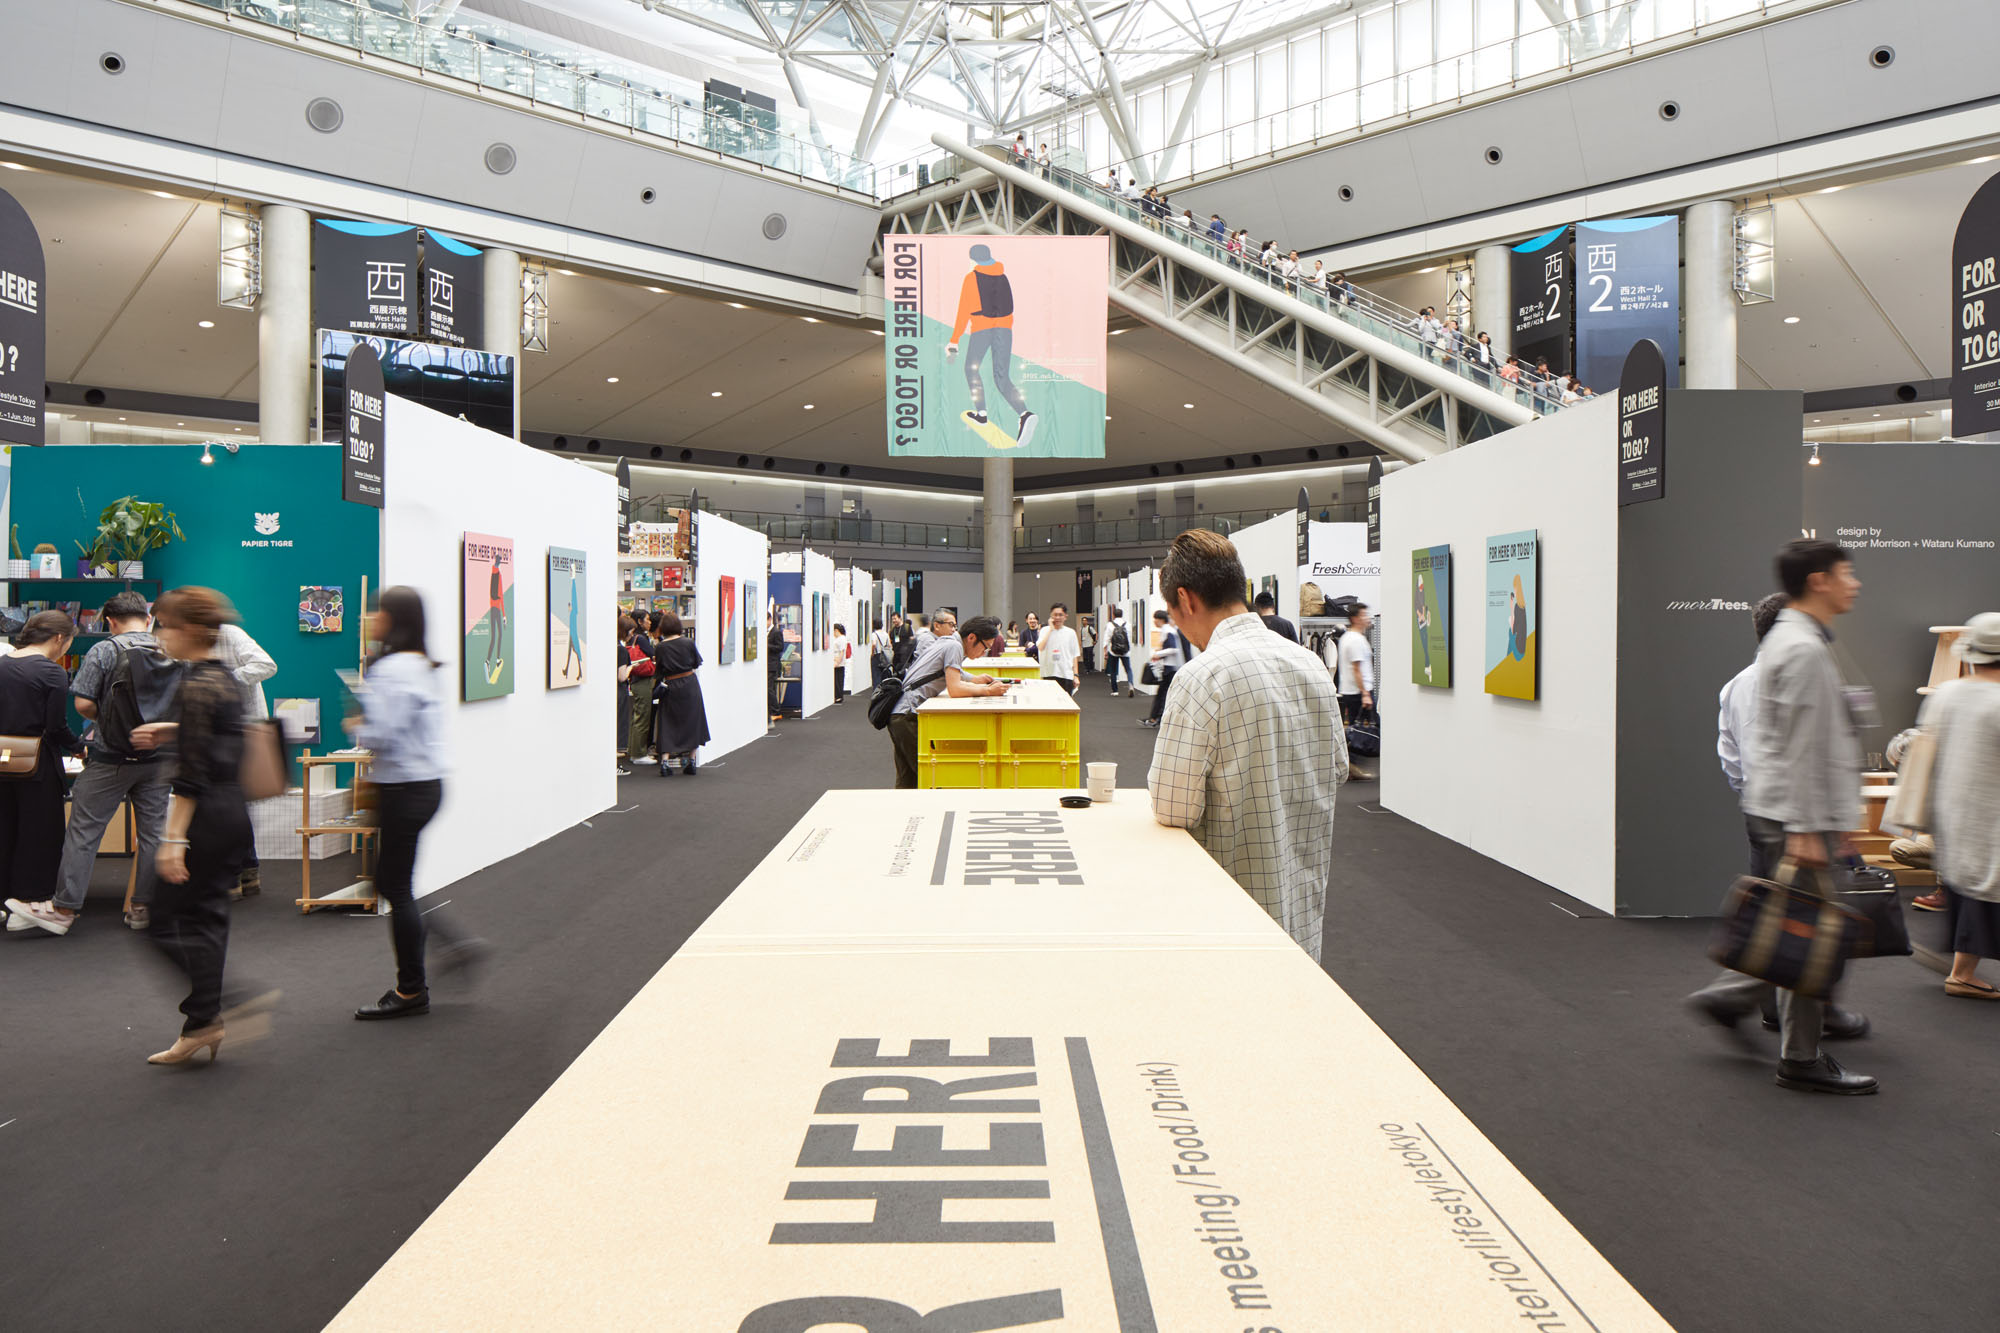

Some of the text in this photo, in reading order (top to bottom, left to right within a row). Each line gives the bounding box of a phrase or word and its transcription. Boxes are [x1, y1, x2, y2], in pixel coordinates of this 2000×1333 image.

[1545, 251, 1563, 284] 西
[1587, 243, 1617, 274] 西
[366, 261, 406, 302] 西
[1962, 256, 1996, 292] FOR
[429, 268, 454, 312] 西
[1546, 283, 1561, 322] 2
[1588, 274, 1614, 312] 2
[1620, 284, 1664, 296] 西2ホール
[1620, 295, 1636, 303] West
[1638, 294, 1651, 302] Hall
[374, 314, 390, 322] West
[1962, 299, 1985, 330] OR
[8, 344, 19, 372] ?
[1986, 330, 2000, 358] G
[18, 394, 36, 406] Tokyo
[1622, 386, 1658, 414] FOR HERE
[1974, 380, 1996, 392] Interior
[350, 388, 382, 416] FOR HERE
[22, 415, 36, 424] 2018
[350, 414, 360, 435] OR
[1622, 420, 1632, 438] OR
[241, 540, 294, 548] PAPIER TIGRE
[1836, 526, 1882, 538] design by
[1837, 538, 1868, 550] Jasper
[1870, 539, 1910, 548] Morrison
[1921, 539, 1954, 548] Wataru
[1956, 539, 1995, 548] Kumano
[468, 543, 477, 558] FOR
[478, 544, 490, 559] HERE
[1489, 546, 1497, 560] FOR
[1498, 544, 1510, 558] HERE
[1510, 543, 1516, 558] OR
[964, 810, 1085, 886] FOR HERE
[768, 1036, 1056, 1245] HERE
